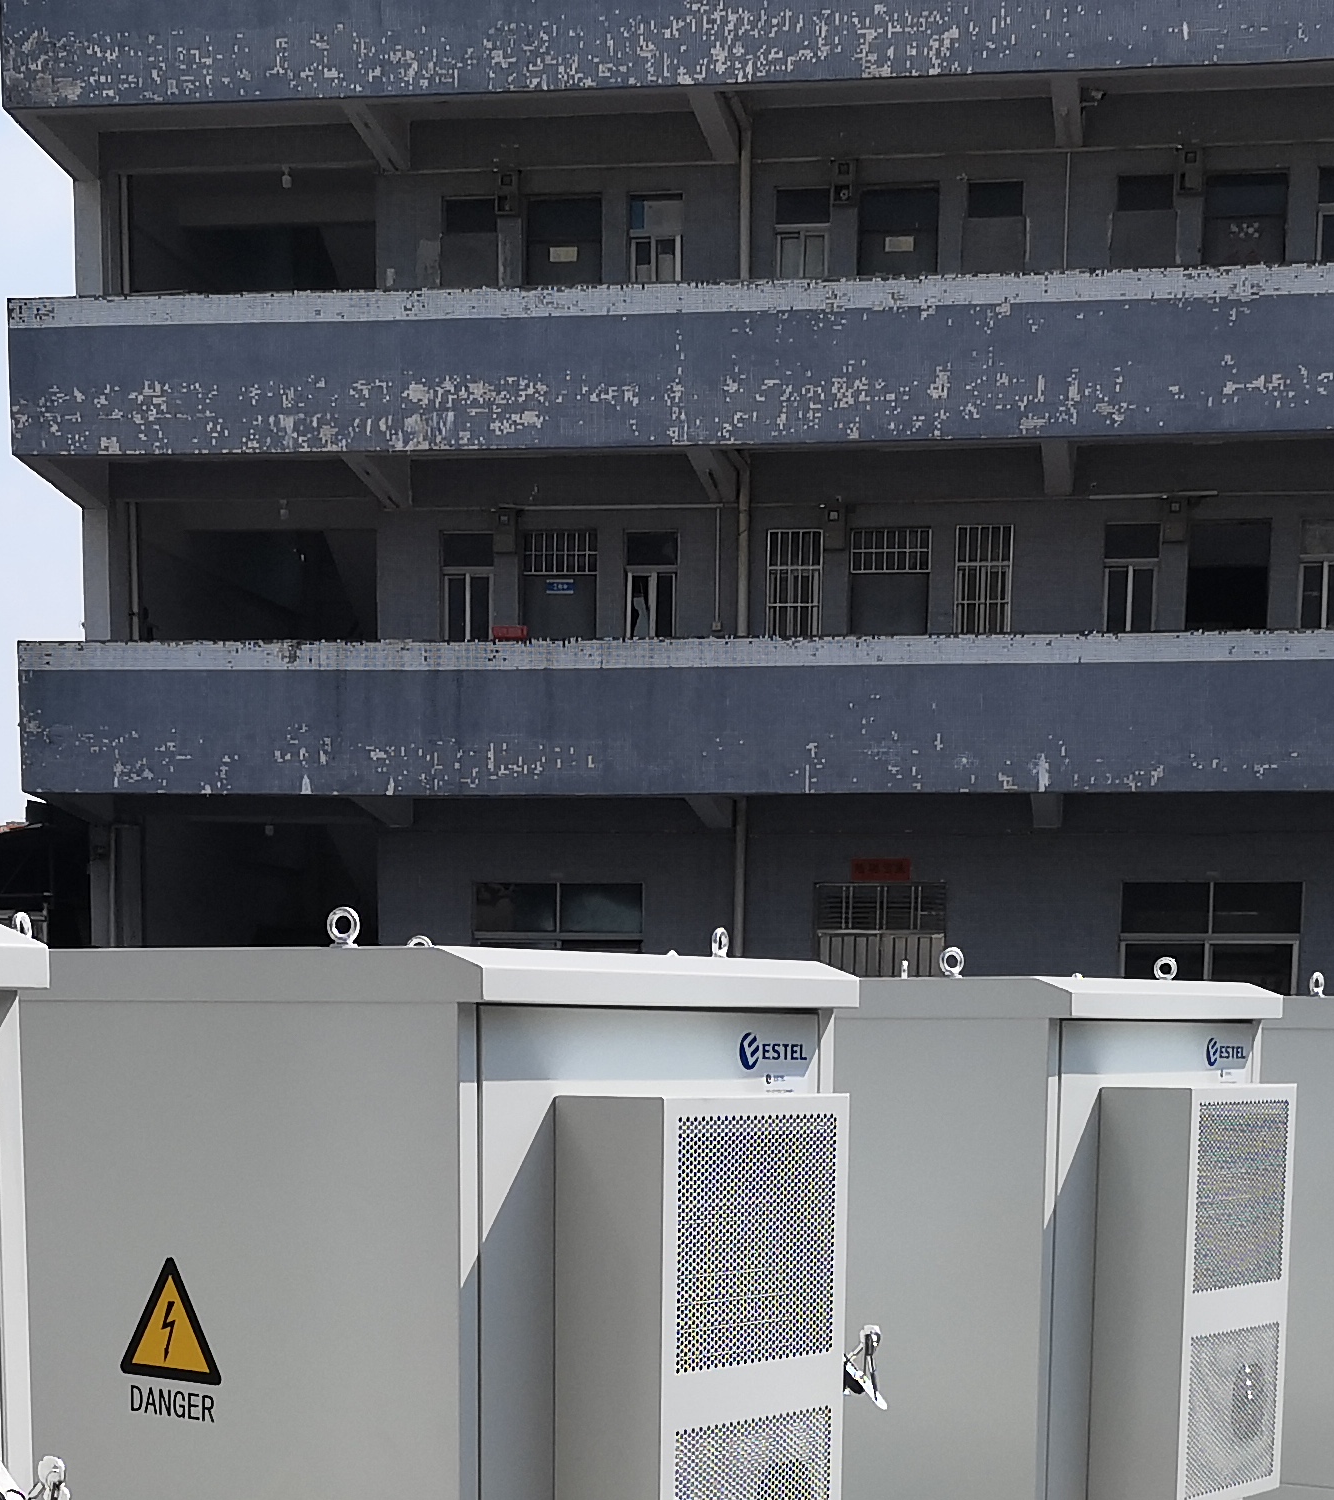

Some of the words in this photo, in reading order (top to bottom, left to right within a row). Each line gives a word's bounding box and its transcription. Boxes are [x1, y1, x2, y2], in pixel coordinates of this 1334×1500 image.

[762, 1043, 807, 1061] ESTEL
[1219, 1045, 1246, 1059] ESTEL
[130, 1384, 215, 1424] DANGER
